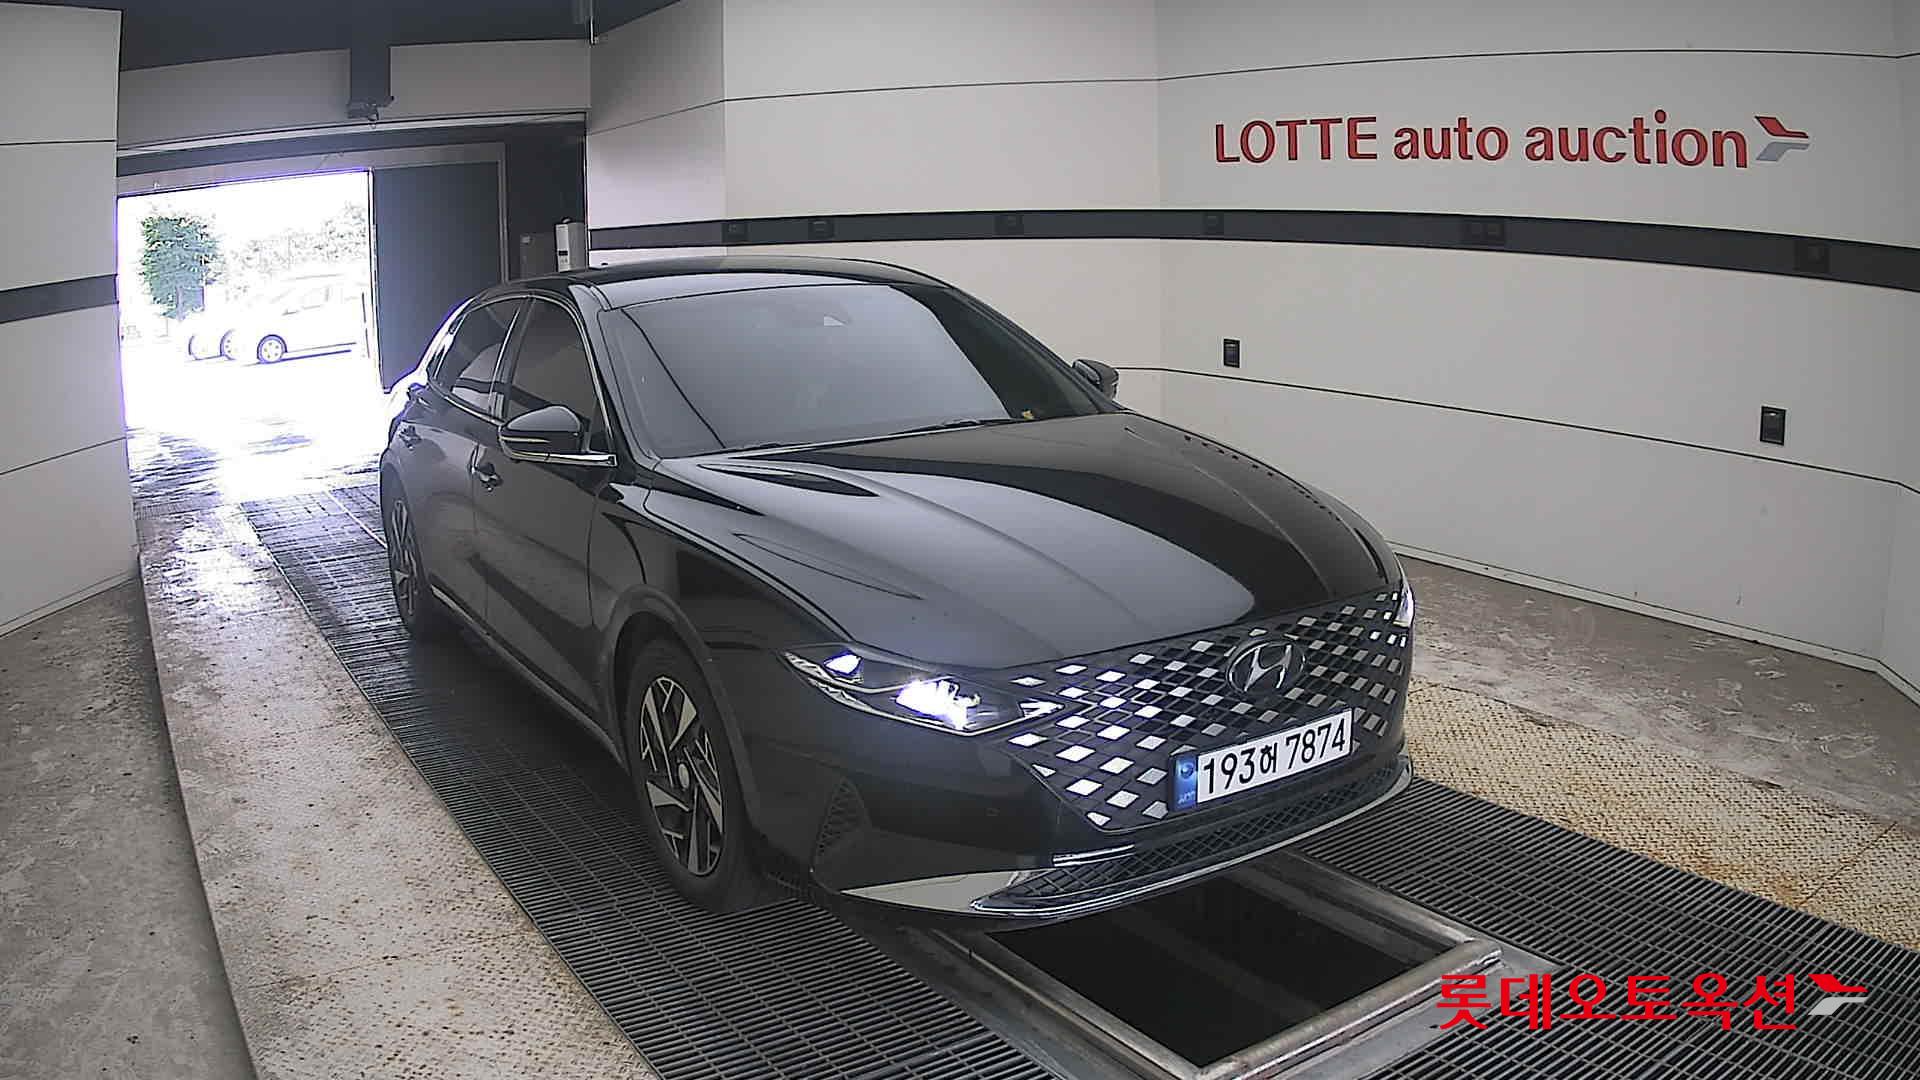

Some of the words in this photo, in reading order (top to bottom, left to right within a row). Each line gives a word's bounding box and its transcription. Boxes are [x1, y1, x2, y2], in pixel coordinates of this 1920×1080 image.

[1215, 116, 1377, 163] LOTTE
[1393, 117, 1509, 161] auto
[1525, 109, 1748, 169] auction
[1203, 742, 1278, 794] 193허
[1285, 718, 1346, 770] 7874
